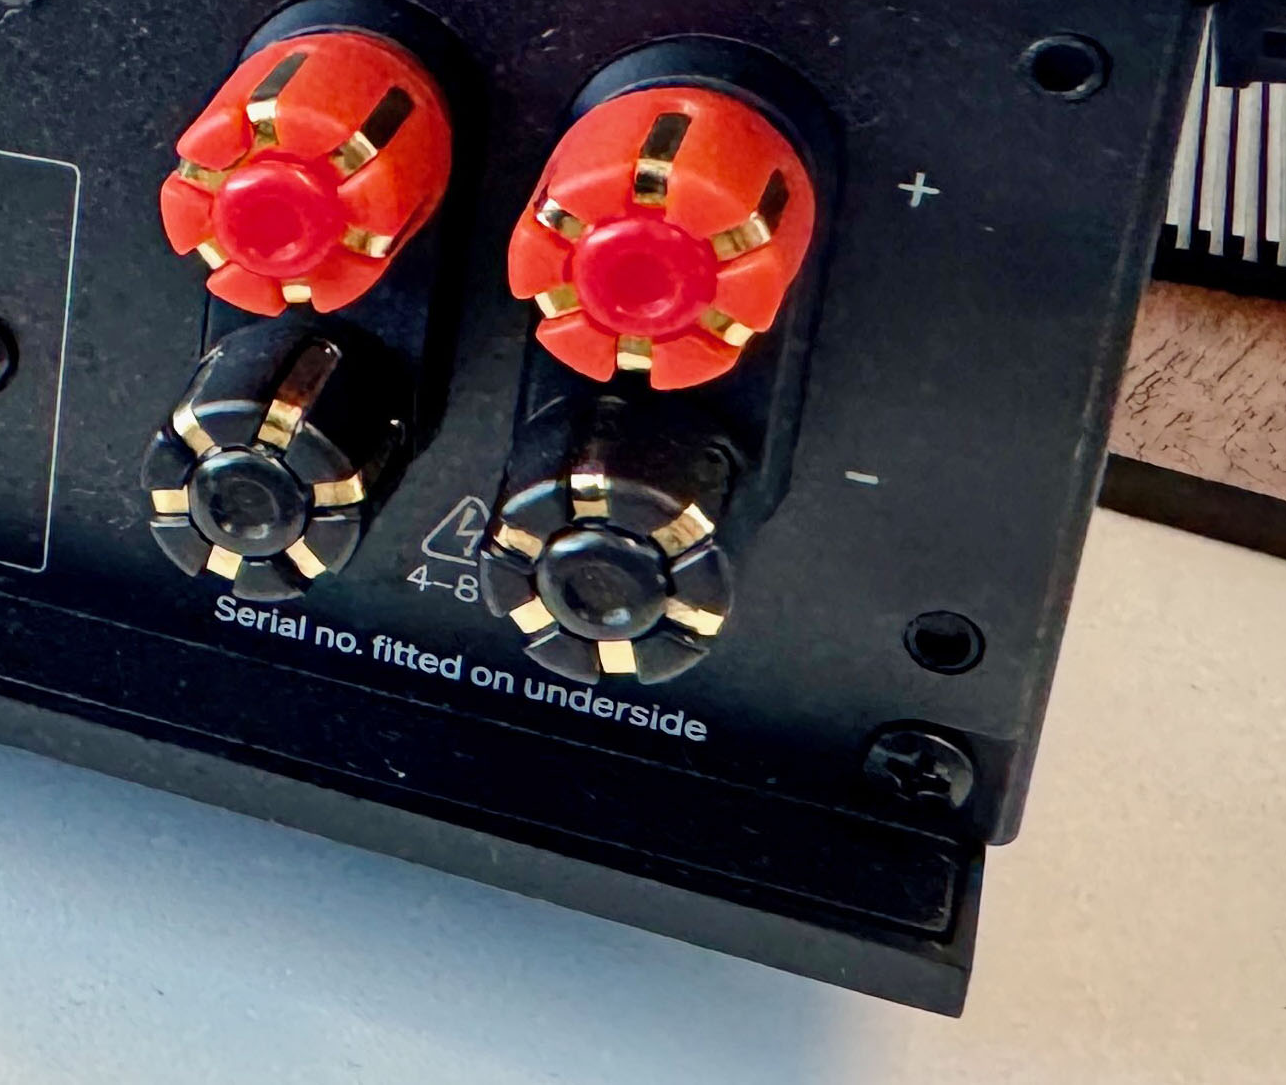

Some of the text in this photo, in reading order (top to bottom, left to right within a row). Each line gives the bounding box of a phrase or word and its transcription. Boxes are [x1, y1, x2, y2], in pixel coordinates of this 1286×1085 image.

[214, 594, 709, 743] Serial no. fitted on underside
